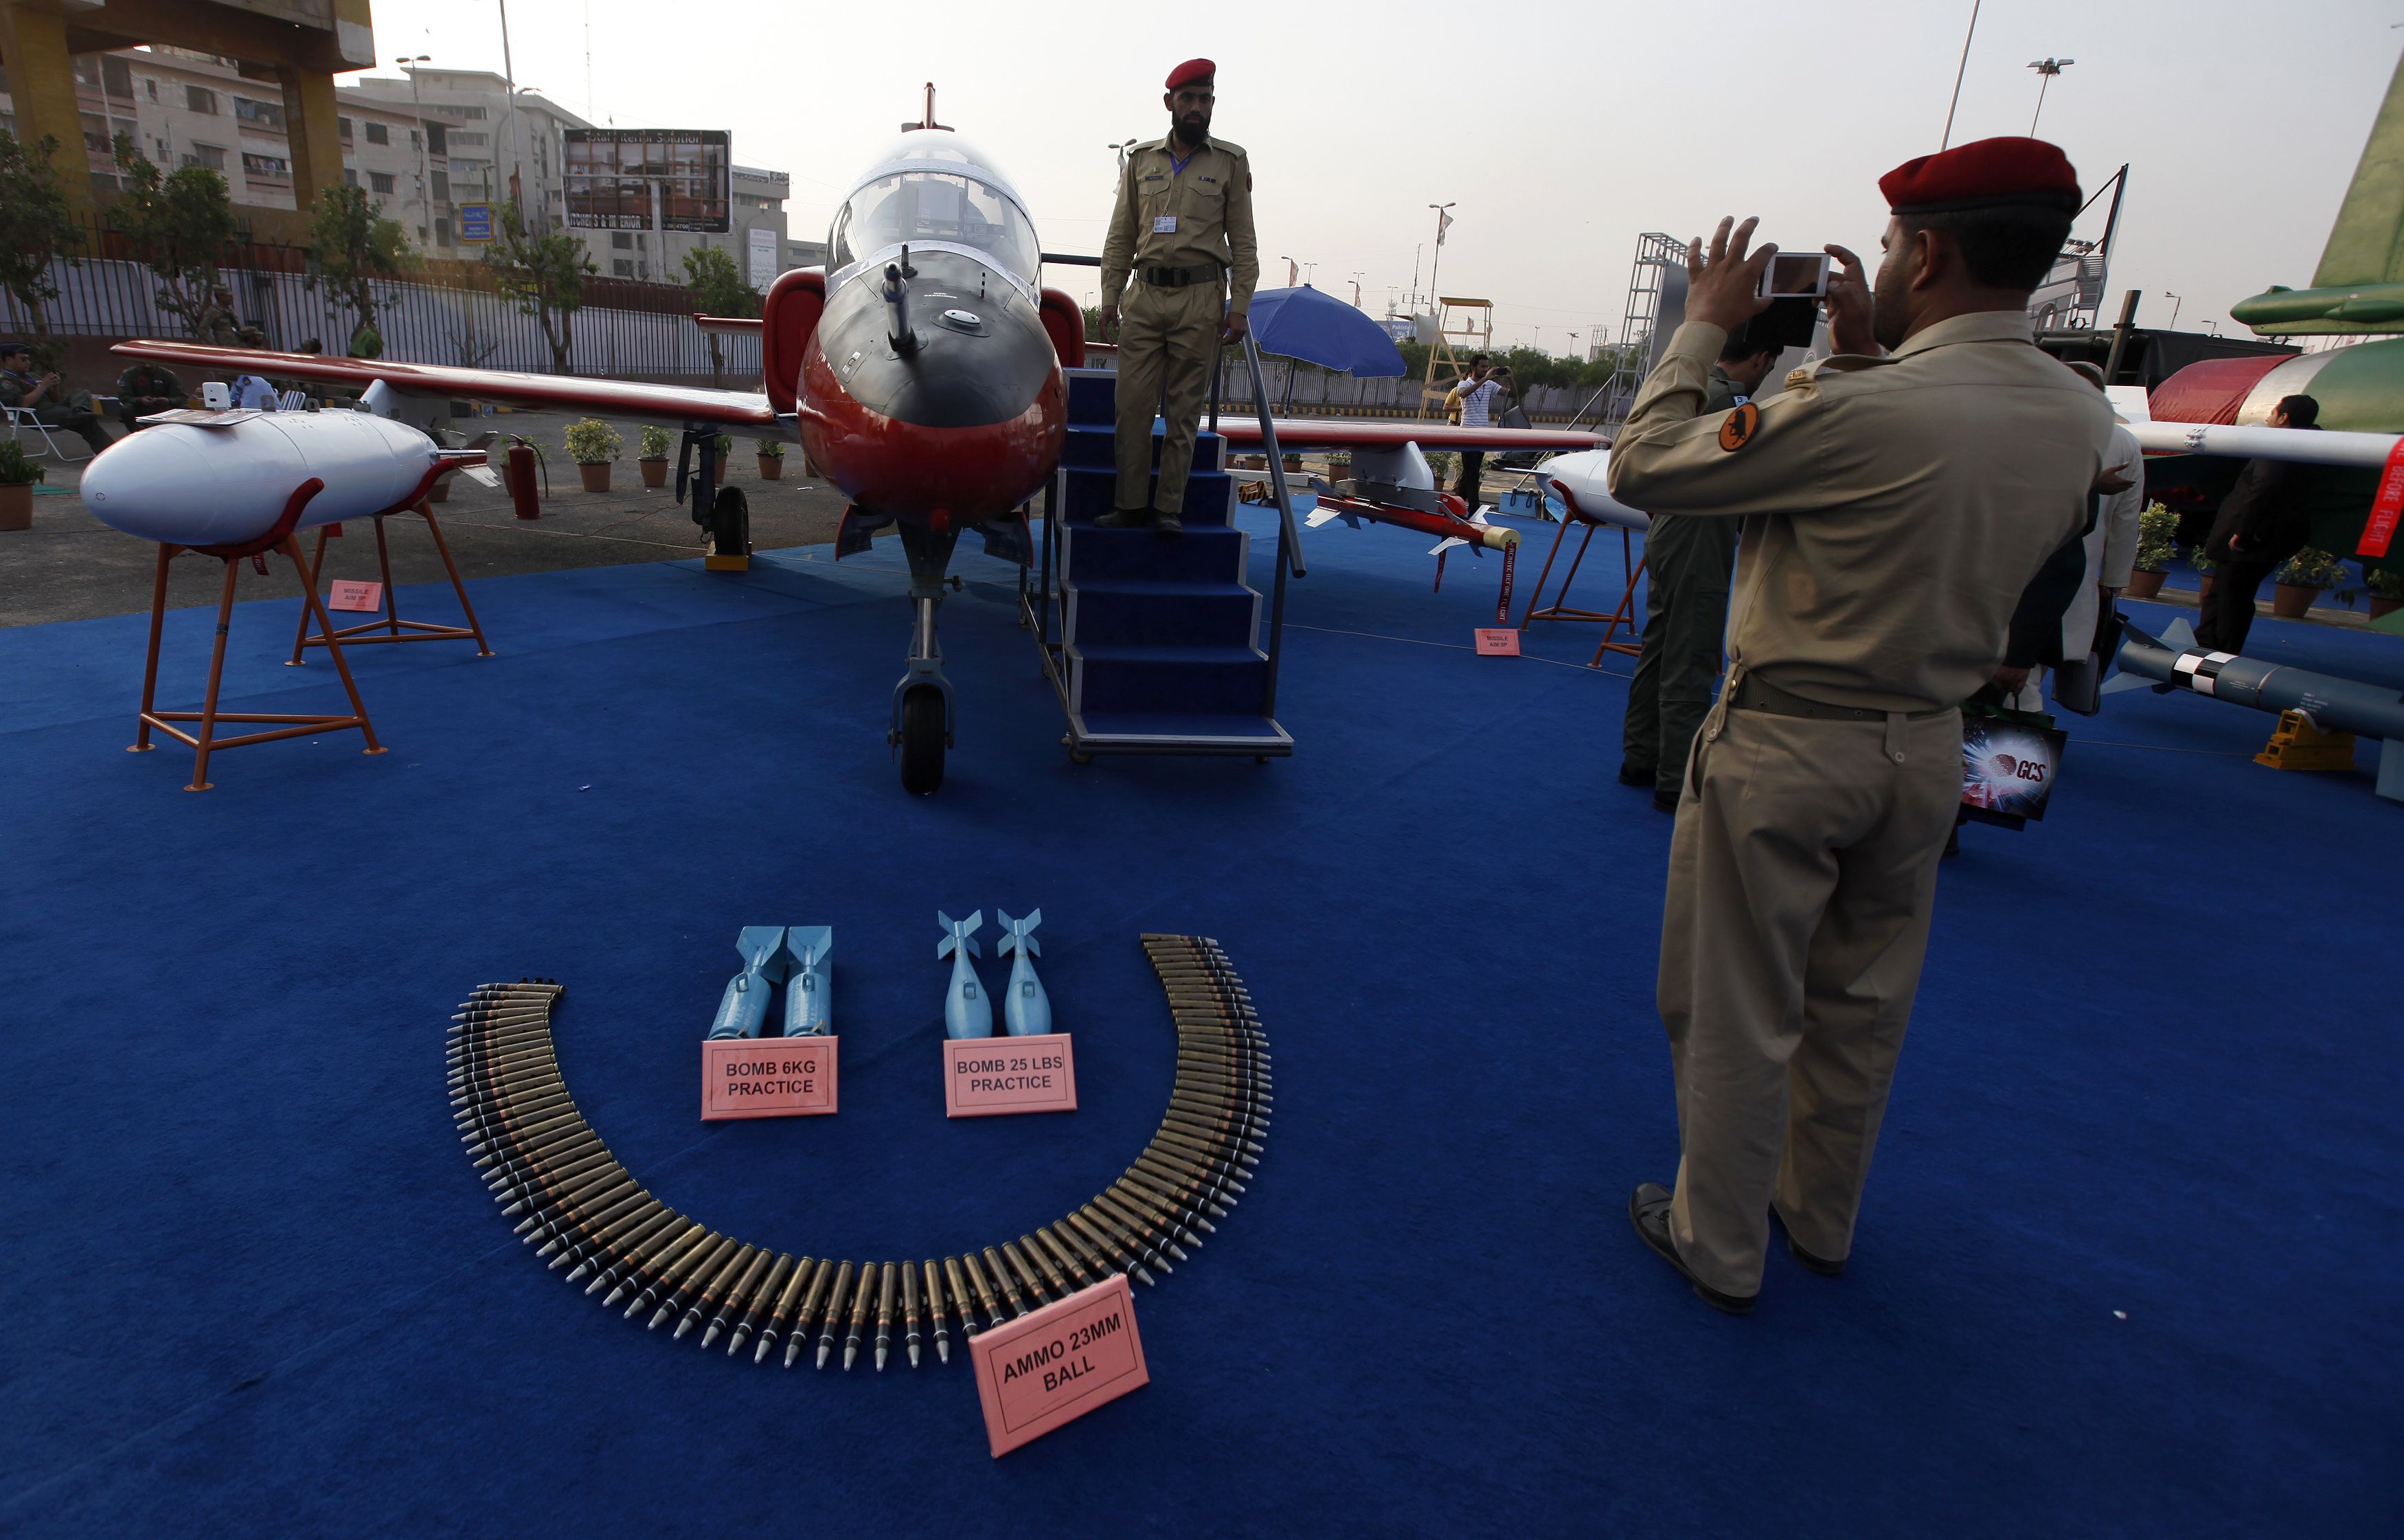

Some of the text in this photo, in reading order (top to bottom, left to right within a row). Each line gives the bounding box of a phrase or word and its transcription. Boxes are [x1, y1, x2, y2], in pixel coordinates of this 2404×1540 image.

[601, 214, 606, 227] &
[609, 214, 641, 229] INERIOR
[2368, 465, 2404, 543] BEFORE FLIGHT
[1499, 548, 1515, 620] REMOVE BEFORE FLIGHT
[2017, 760, 2047, 782] GCS
[725, 1060, 816, 1077] BOMB 6KG
[957, 1056, 1063, 1074] BOMB 25 LBS
[727, 1079, 814, 1096] PRACTICE
[971, 1075, 1052, 1093] PRACTICE
[1003, 1313, 1122, 1384] AMMO 23MM
[1043, 1356, 1096, 1392] BALL
